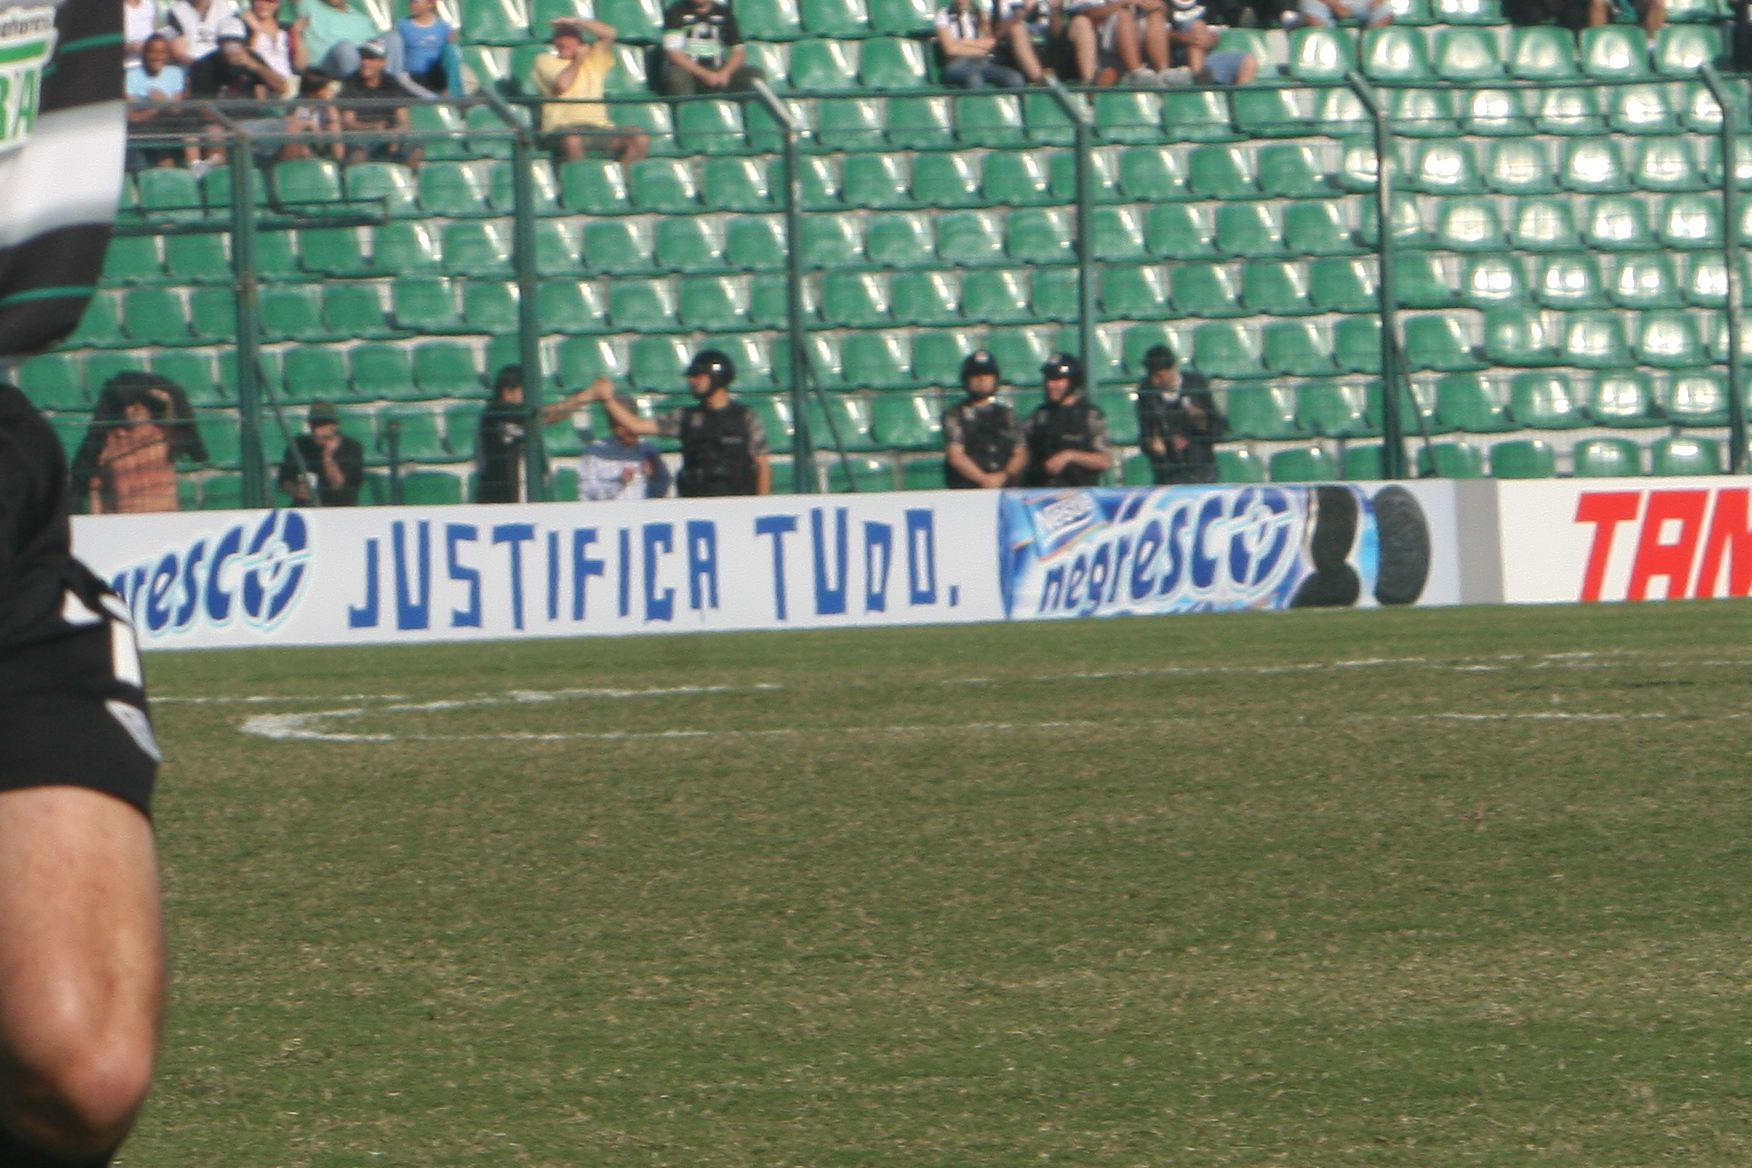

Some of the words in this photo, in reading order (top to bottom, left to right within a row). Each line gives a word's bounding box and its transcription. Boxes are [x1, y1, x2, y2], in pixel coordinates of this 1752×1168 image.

[349, 518, 719, 632] JUSTIFICA
[755, 506, 959, 622] TUDO.
[1037, 487, 1292, 617] negresco
